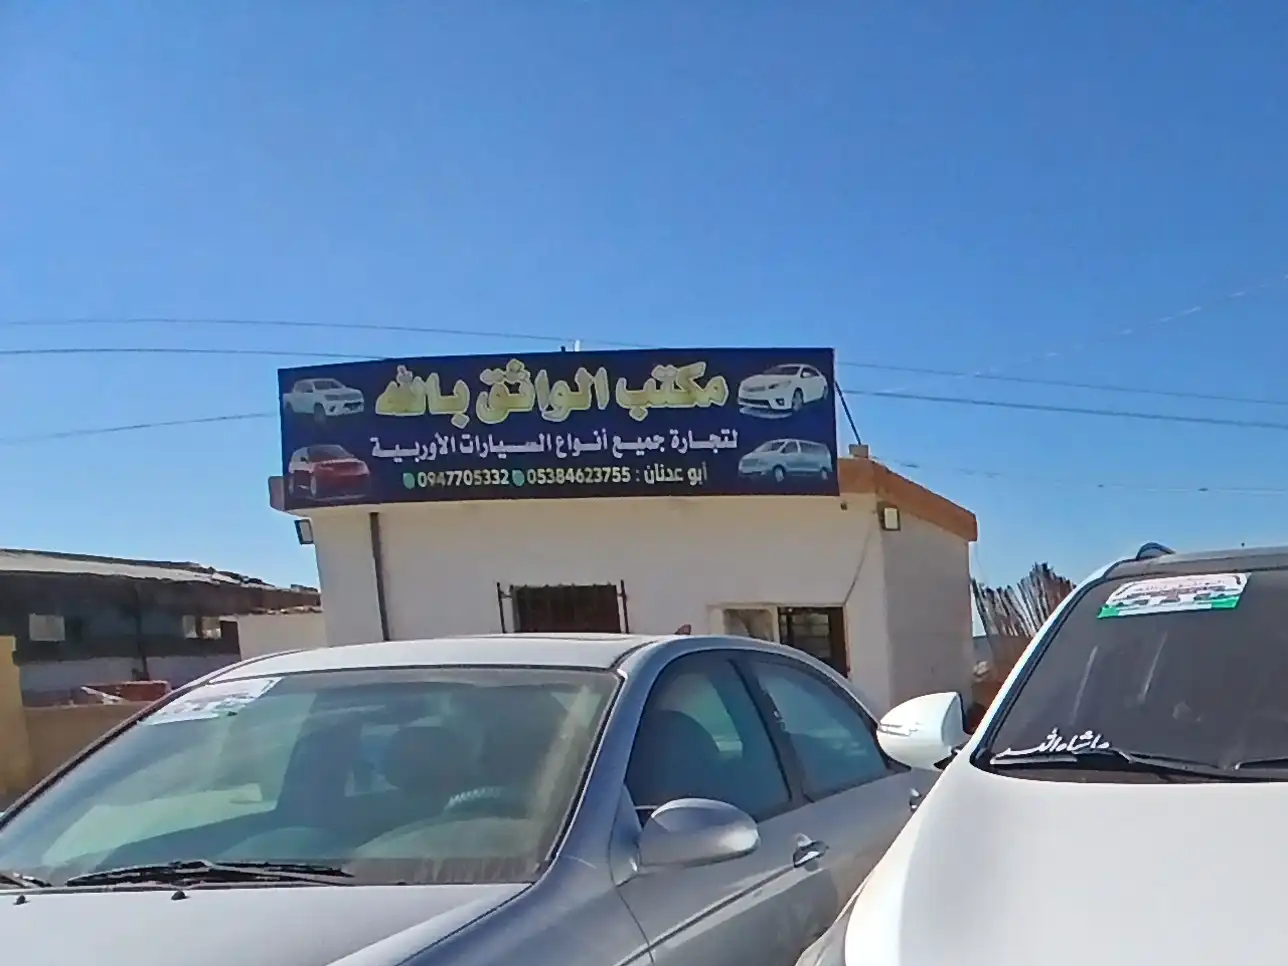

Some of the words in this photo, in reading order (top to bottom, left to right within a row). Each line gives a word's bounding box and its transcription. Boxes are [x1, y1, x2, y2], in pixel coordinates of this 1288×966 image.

[375, 365, 470, 429] بالله
[476, 358, 610, 424] الواثق
[615, 361, 729, 421] مكتب
[370, 432, 456, 463] الأوربية
[459, 433, 552, 459] السيارات
[555, 428, 608, 458] أنواع
[612, 434, 665, 458] جميع
[669, 428, 738, 454] لتجارة
[417, 468, 509, 488] 0947705332
[527, 466, 631, 485] 05384623755
[643, 462, 684, 485] عدنان
